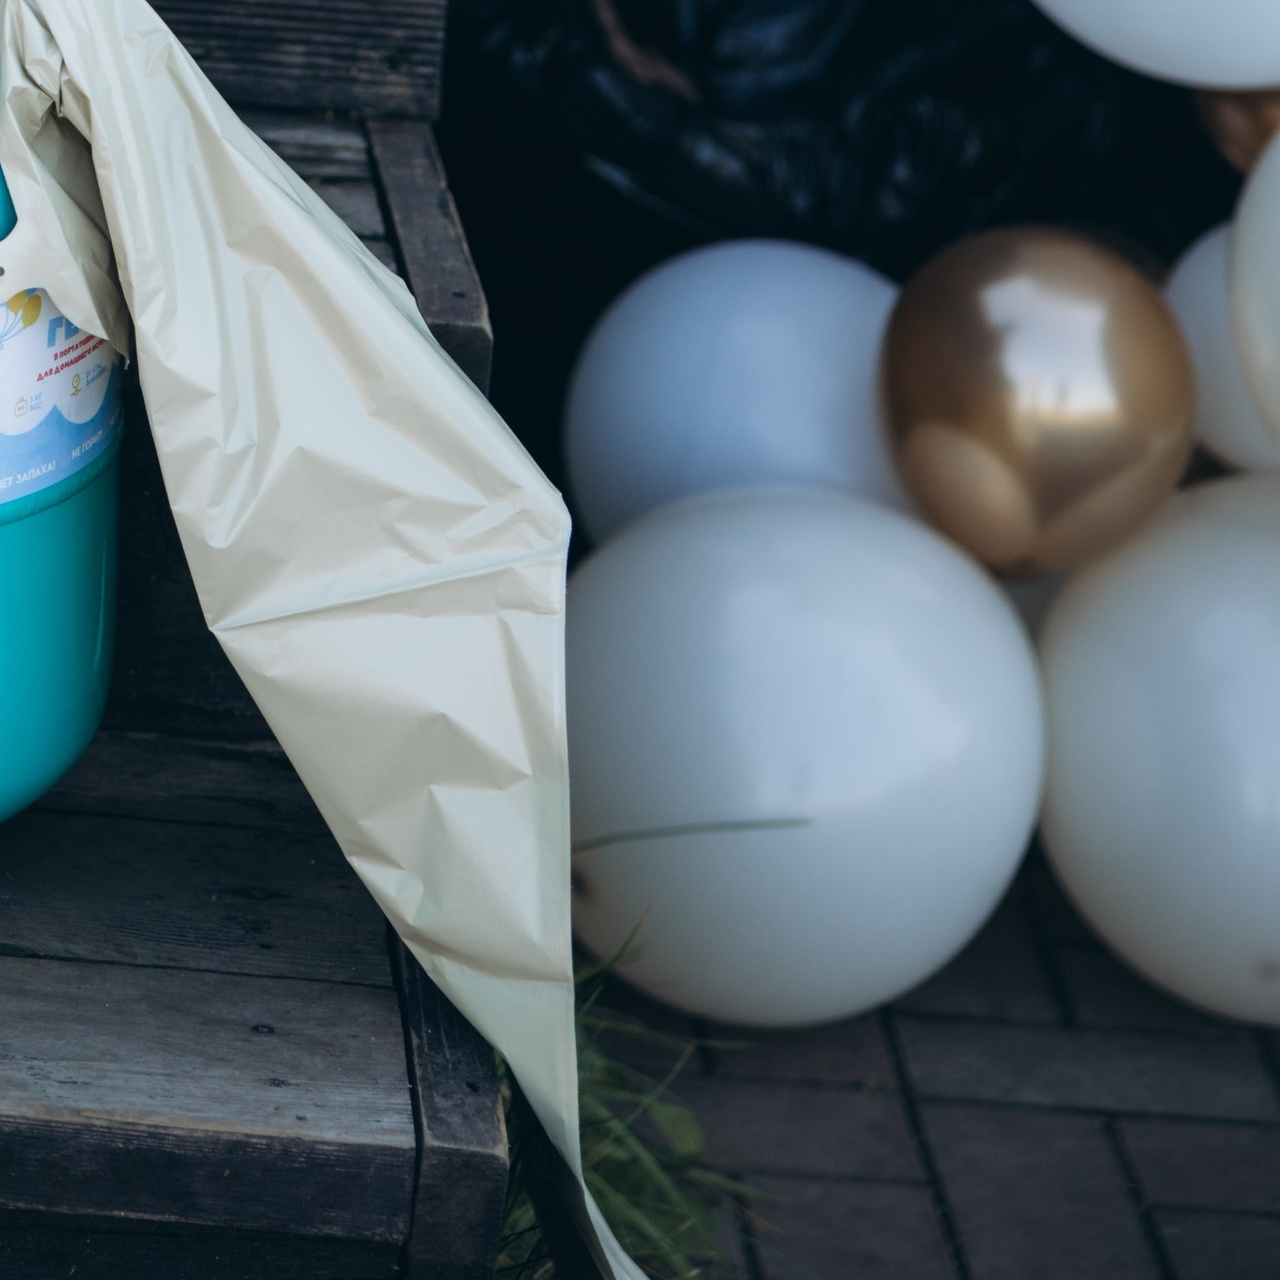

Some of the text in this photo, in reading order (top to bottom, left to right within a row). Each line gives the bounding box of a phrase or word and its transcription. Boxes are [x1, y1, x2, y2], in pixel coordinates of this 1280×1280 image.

[37, 367, 53, 382] ДЛЯ
[71, 445, 81, 460] НЕ
[15, 460, 56, 484] ЗАПАХА!
